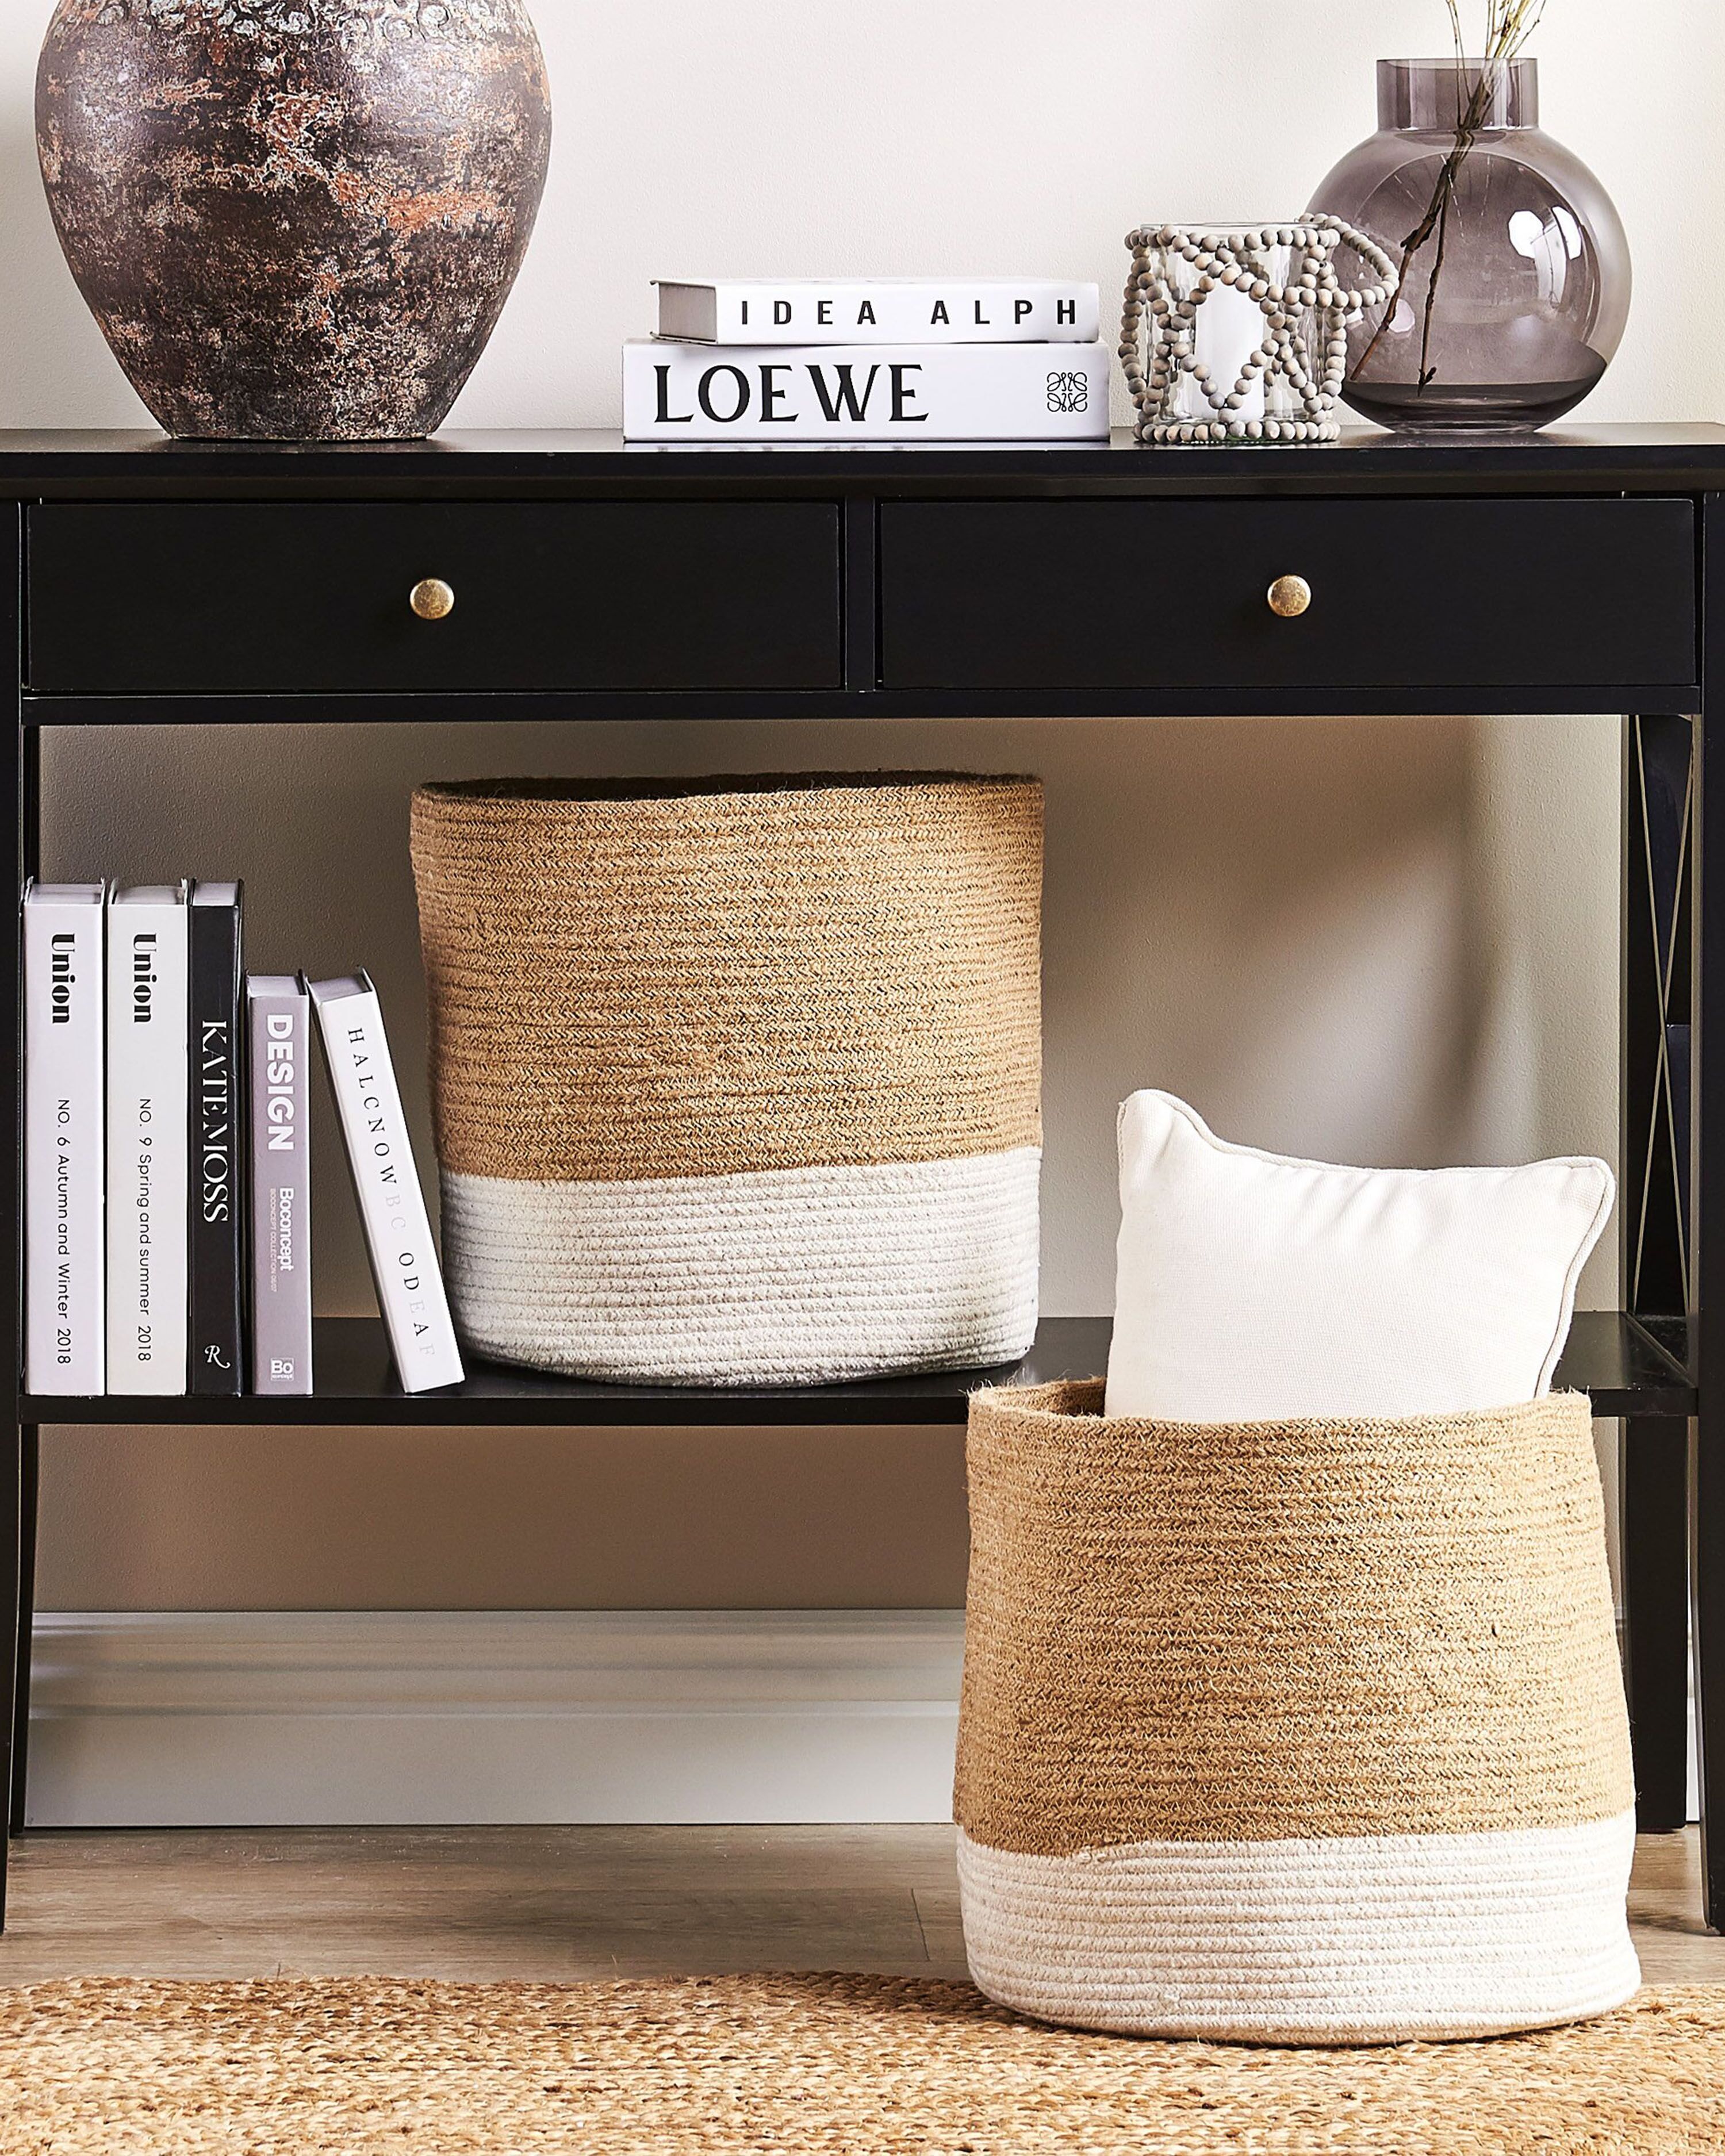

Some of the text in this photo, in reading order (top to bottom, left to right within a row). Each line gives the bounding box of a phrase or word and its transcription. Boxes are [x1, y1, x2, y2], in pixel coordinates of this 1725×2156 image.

[741, 299, 1076, 325] IDEA ALPH
[653, 364, 929, 423] LOEWE
[52, 933, 75, 1024] Union
[133, 933, 157, 1023] Union
[267, 1015, 294, 1150] DESIGN
[57, 1099, 71, 1364] NO. 6 Autumn and Winter 2018
[137, 1099, 152, 1361] NO. 9 Spring and summer 2018
[278, 1188, 294, 1271] Boconcept
[271, 1360, 293, 1374] Bo
